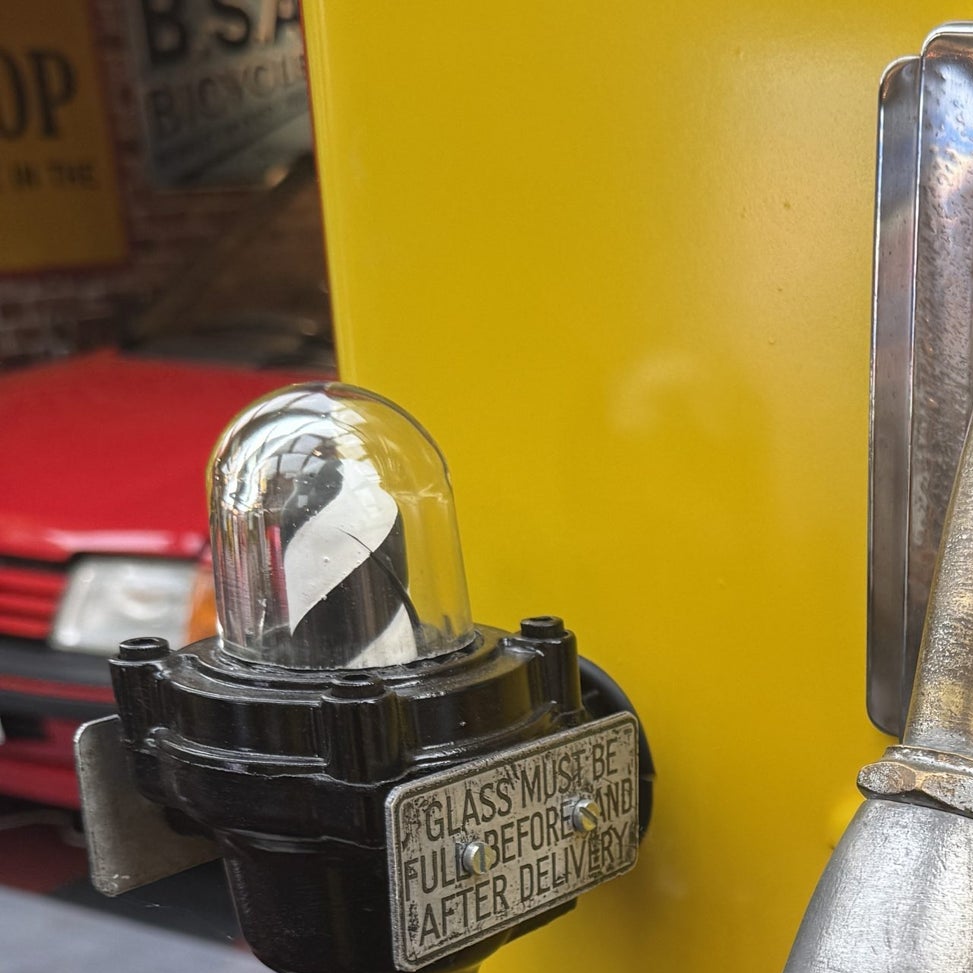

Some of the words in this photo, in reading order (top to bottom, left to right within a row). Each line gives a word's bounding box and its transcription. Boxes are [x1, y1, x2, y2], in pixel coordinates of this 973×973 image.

[149, 56, 306, 140] BICYCL
[404, 842, 475, 902] FULL
[484, 799, 574, 870] BEFORE
[594, 777, 633, 823] AND
[425, 777, 513, 842] GLASS
[520, 748, 586, 809] MUST
[591, 738, 618, 781] BE
[418, 874, 510, 947] AFTER
[519, 821, 629, 903] DELIVERY
